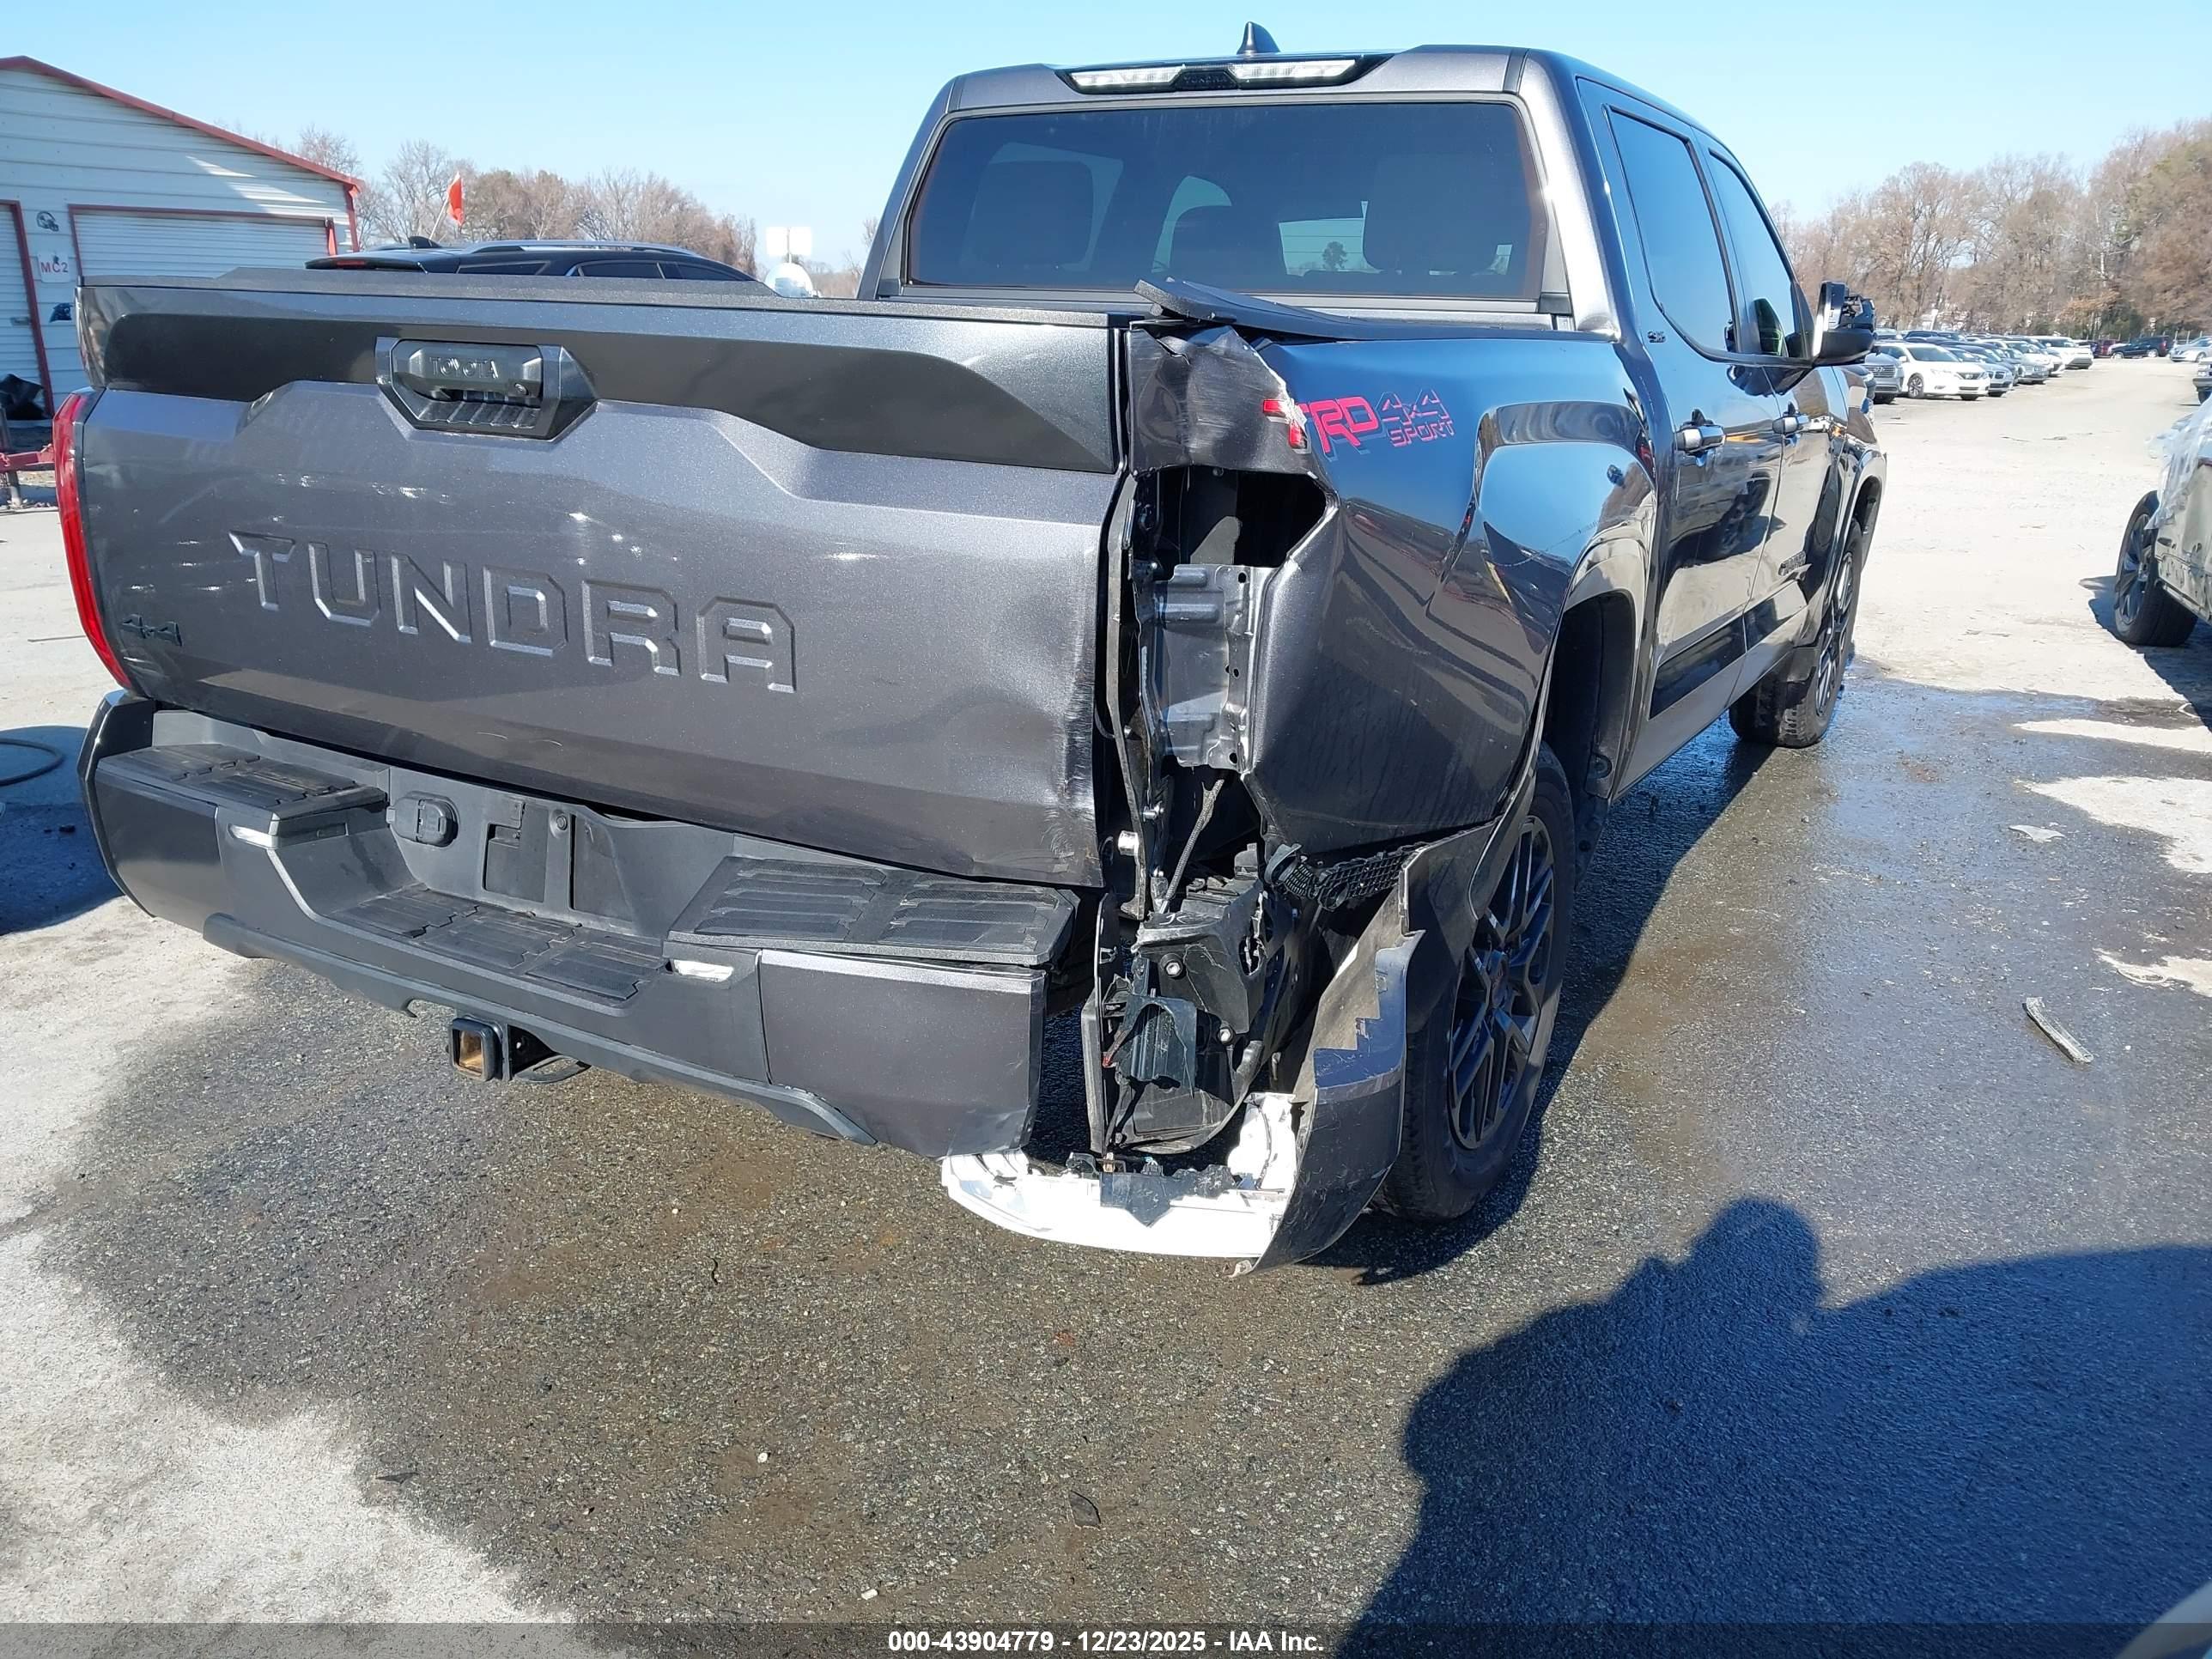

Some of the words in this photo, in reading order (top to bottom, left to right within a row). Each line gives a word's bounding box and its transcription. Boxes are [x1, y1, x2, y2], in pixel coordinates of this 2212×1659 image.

[40, 261, 69, 273] MC2
[428, 356, 499, 379] TOYOTA
[1262, 396, 1381, 456] TRD
[1387, 419, 1455, 447] SPORT
[228, 530, 799, 694] TUNDRA
